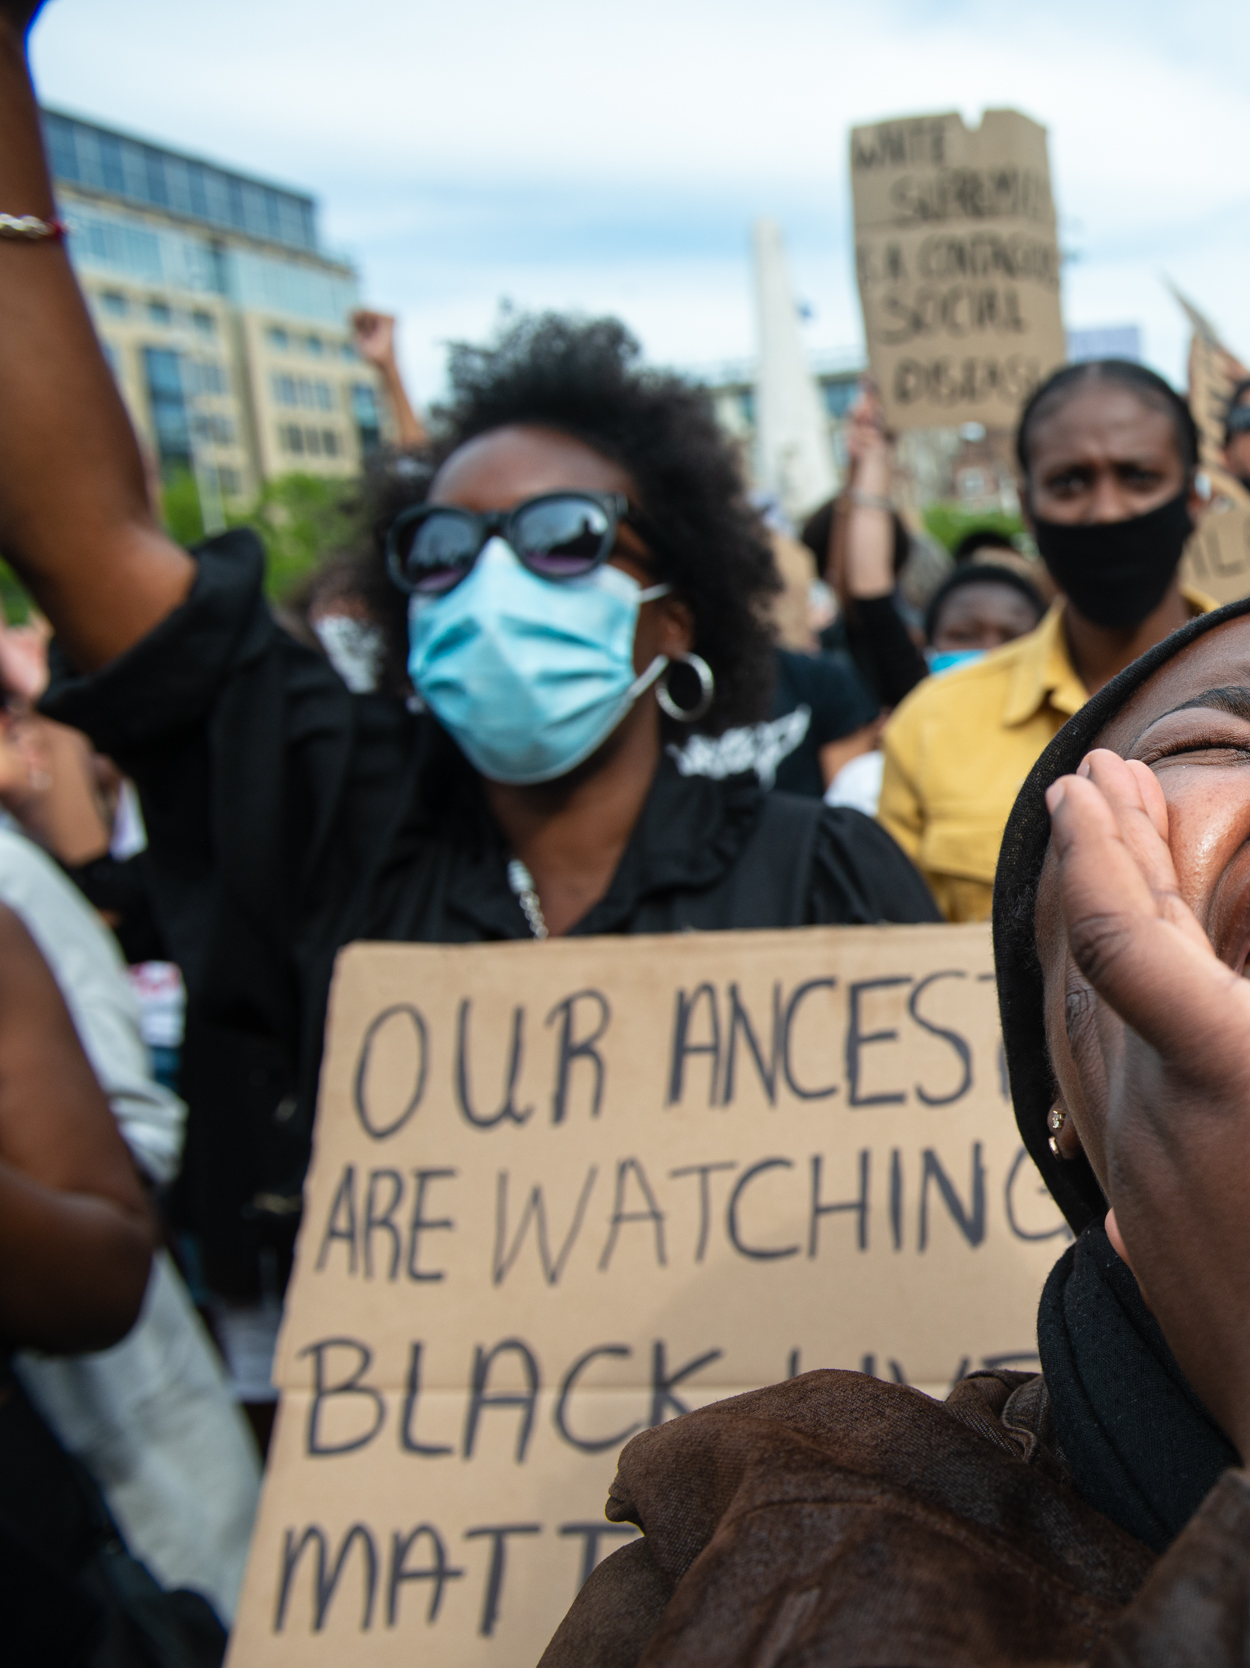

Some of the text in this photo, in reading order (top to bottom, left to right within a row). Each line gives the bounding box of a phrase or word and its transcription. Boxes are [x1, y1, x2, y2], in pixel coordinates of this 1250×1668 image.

[880, 285, 1026, 345] SOCIAL
[354, 971, 1011, 1141] OUR ANCES
[315, 1162, 458, 1282] ARE
